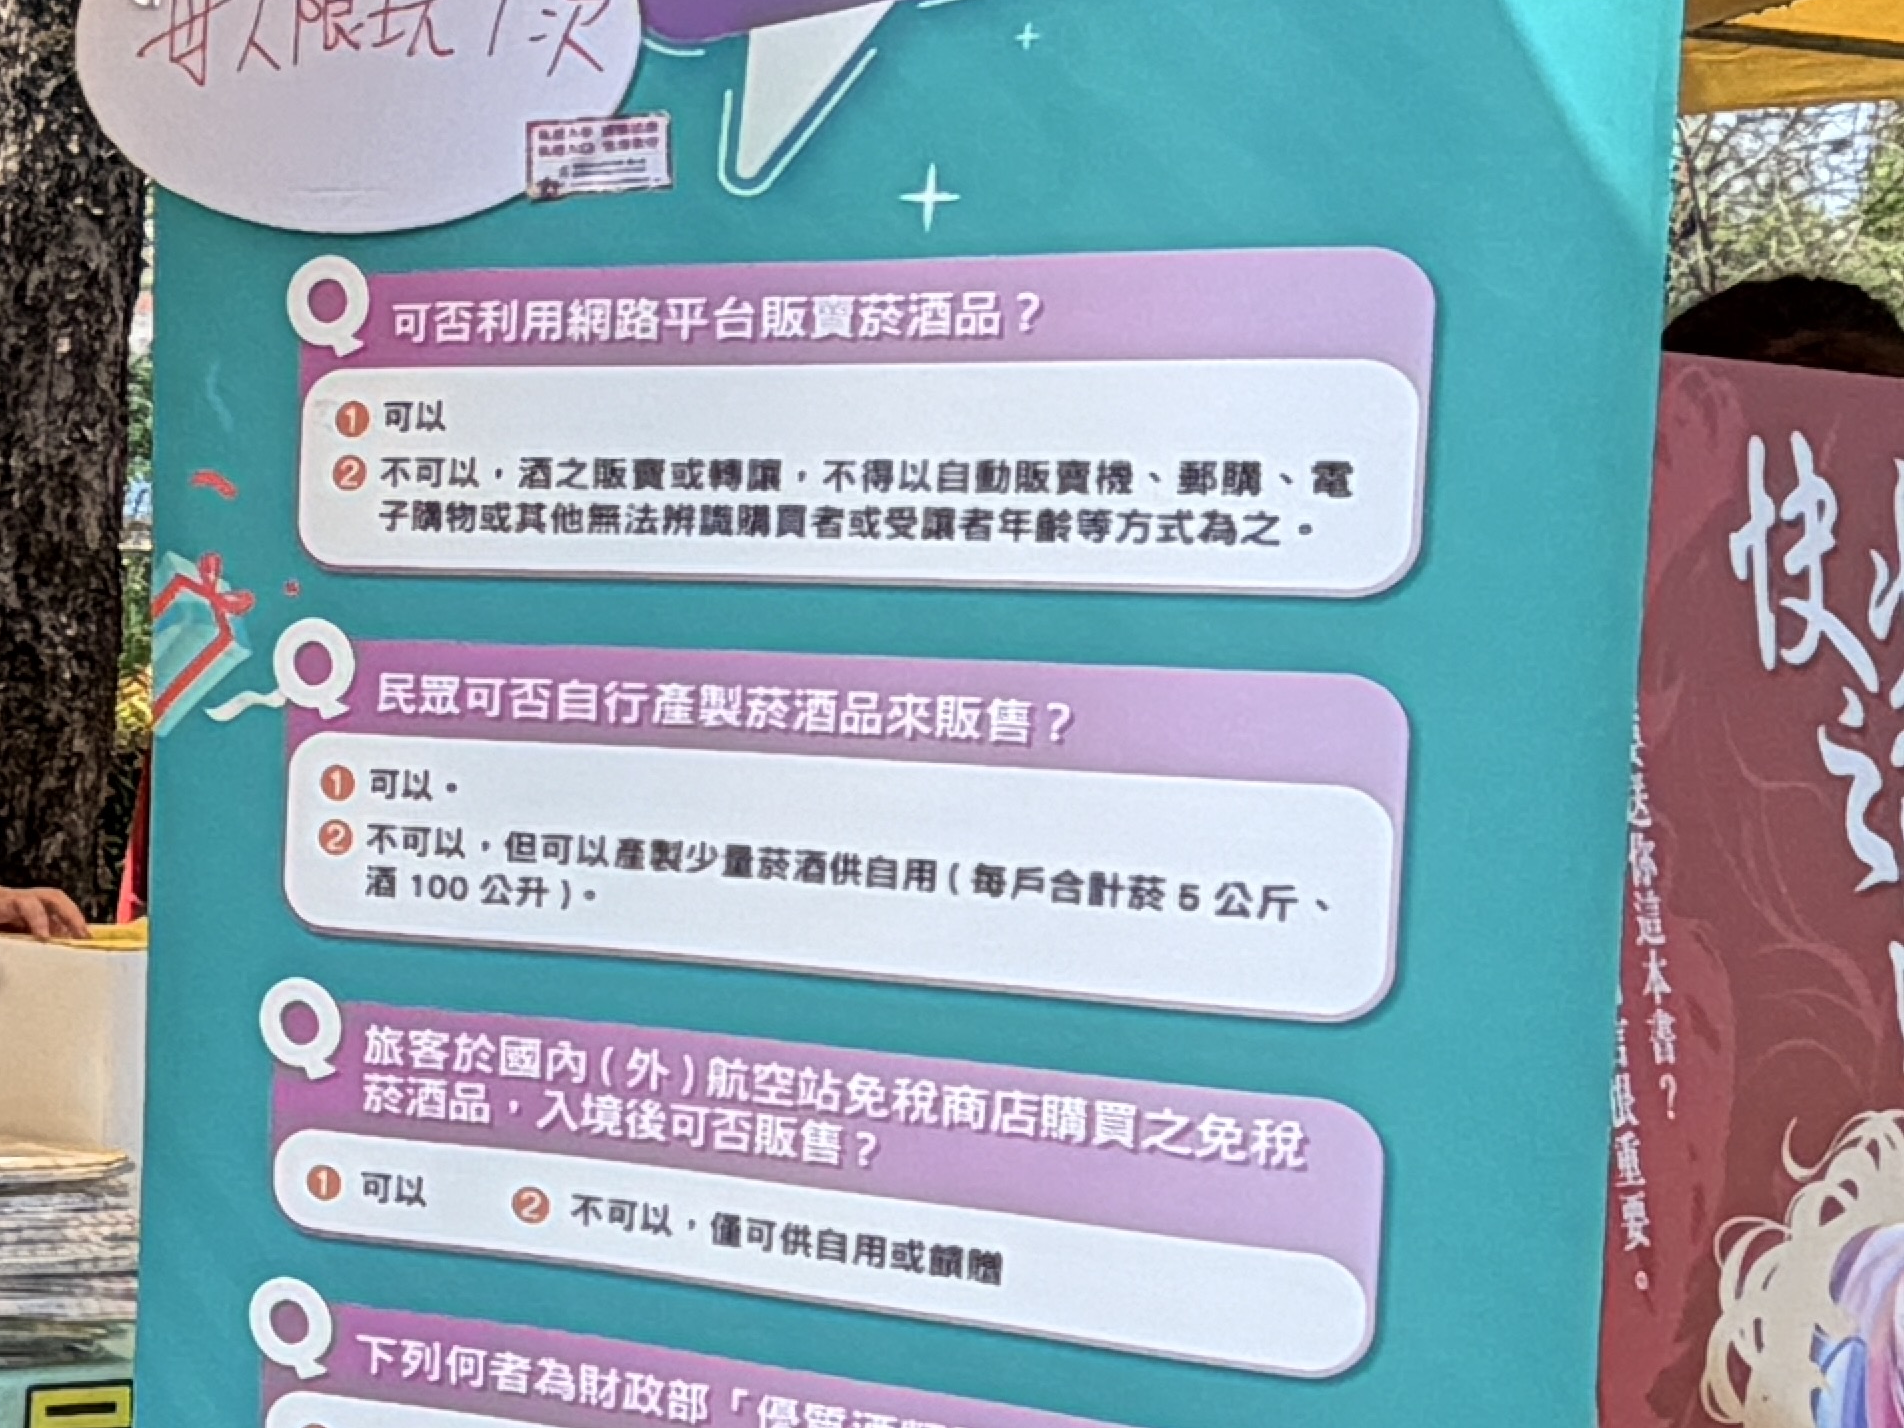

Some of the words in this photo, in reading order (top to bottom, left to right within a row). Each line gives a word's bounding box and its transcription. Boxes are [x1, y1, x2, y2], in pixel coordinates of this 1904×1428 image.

[392, 291, 1045, 344] 可否利用網路平台販賣菸酒品？
[384, 399, 447, 433] 可以
[377, 670, 1075, 746] 民眾可否自行產製菸酒品來販售？
[361, 1172, 427, 1207] 可以
